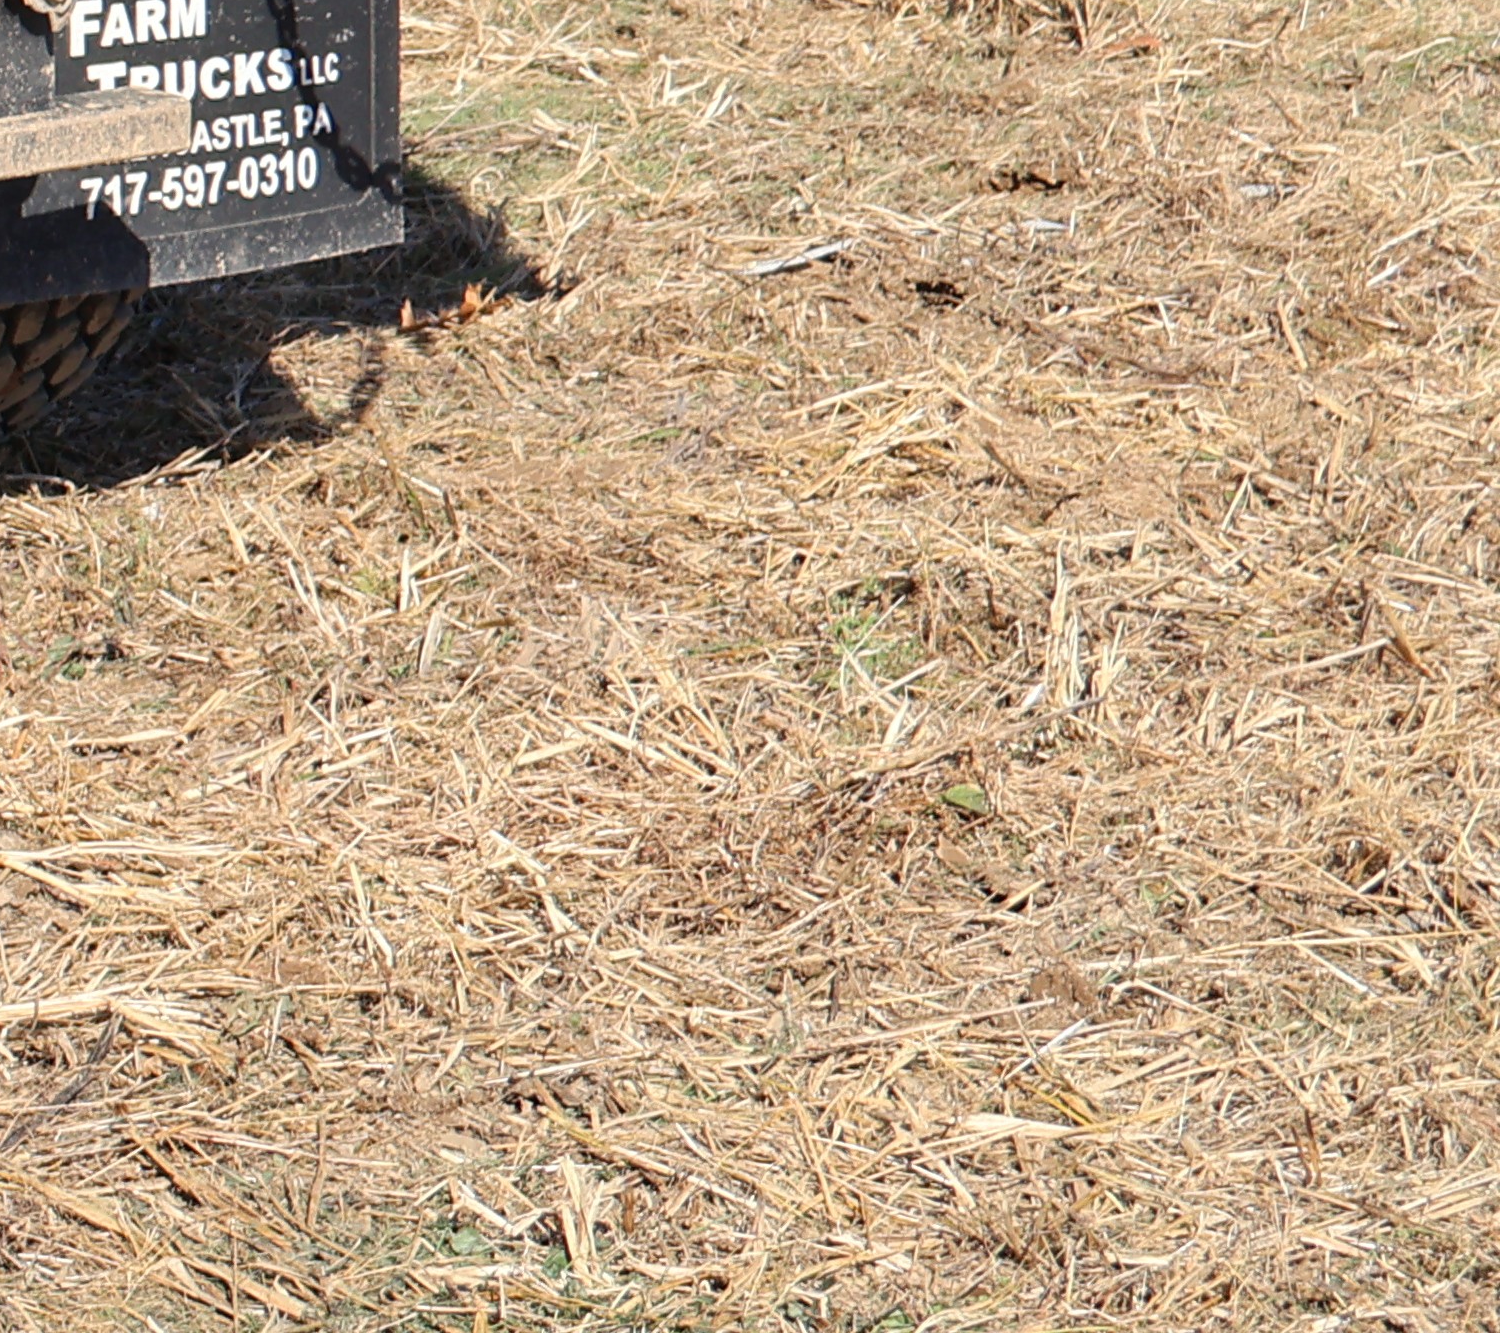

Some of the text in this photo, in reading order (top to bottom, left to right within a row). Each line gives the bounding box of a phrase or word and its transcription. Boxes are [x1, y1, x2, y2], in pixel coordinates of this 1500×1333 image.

[299, 51, 341, 87] LLC
[294, 101, 333, 139] PA
[80, 147, 318, 221] 717-597-0310
